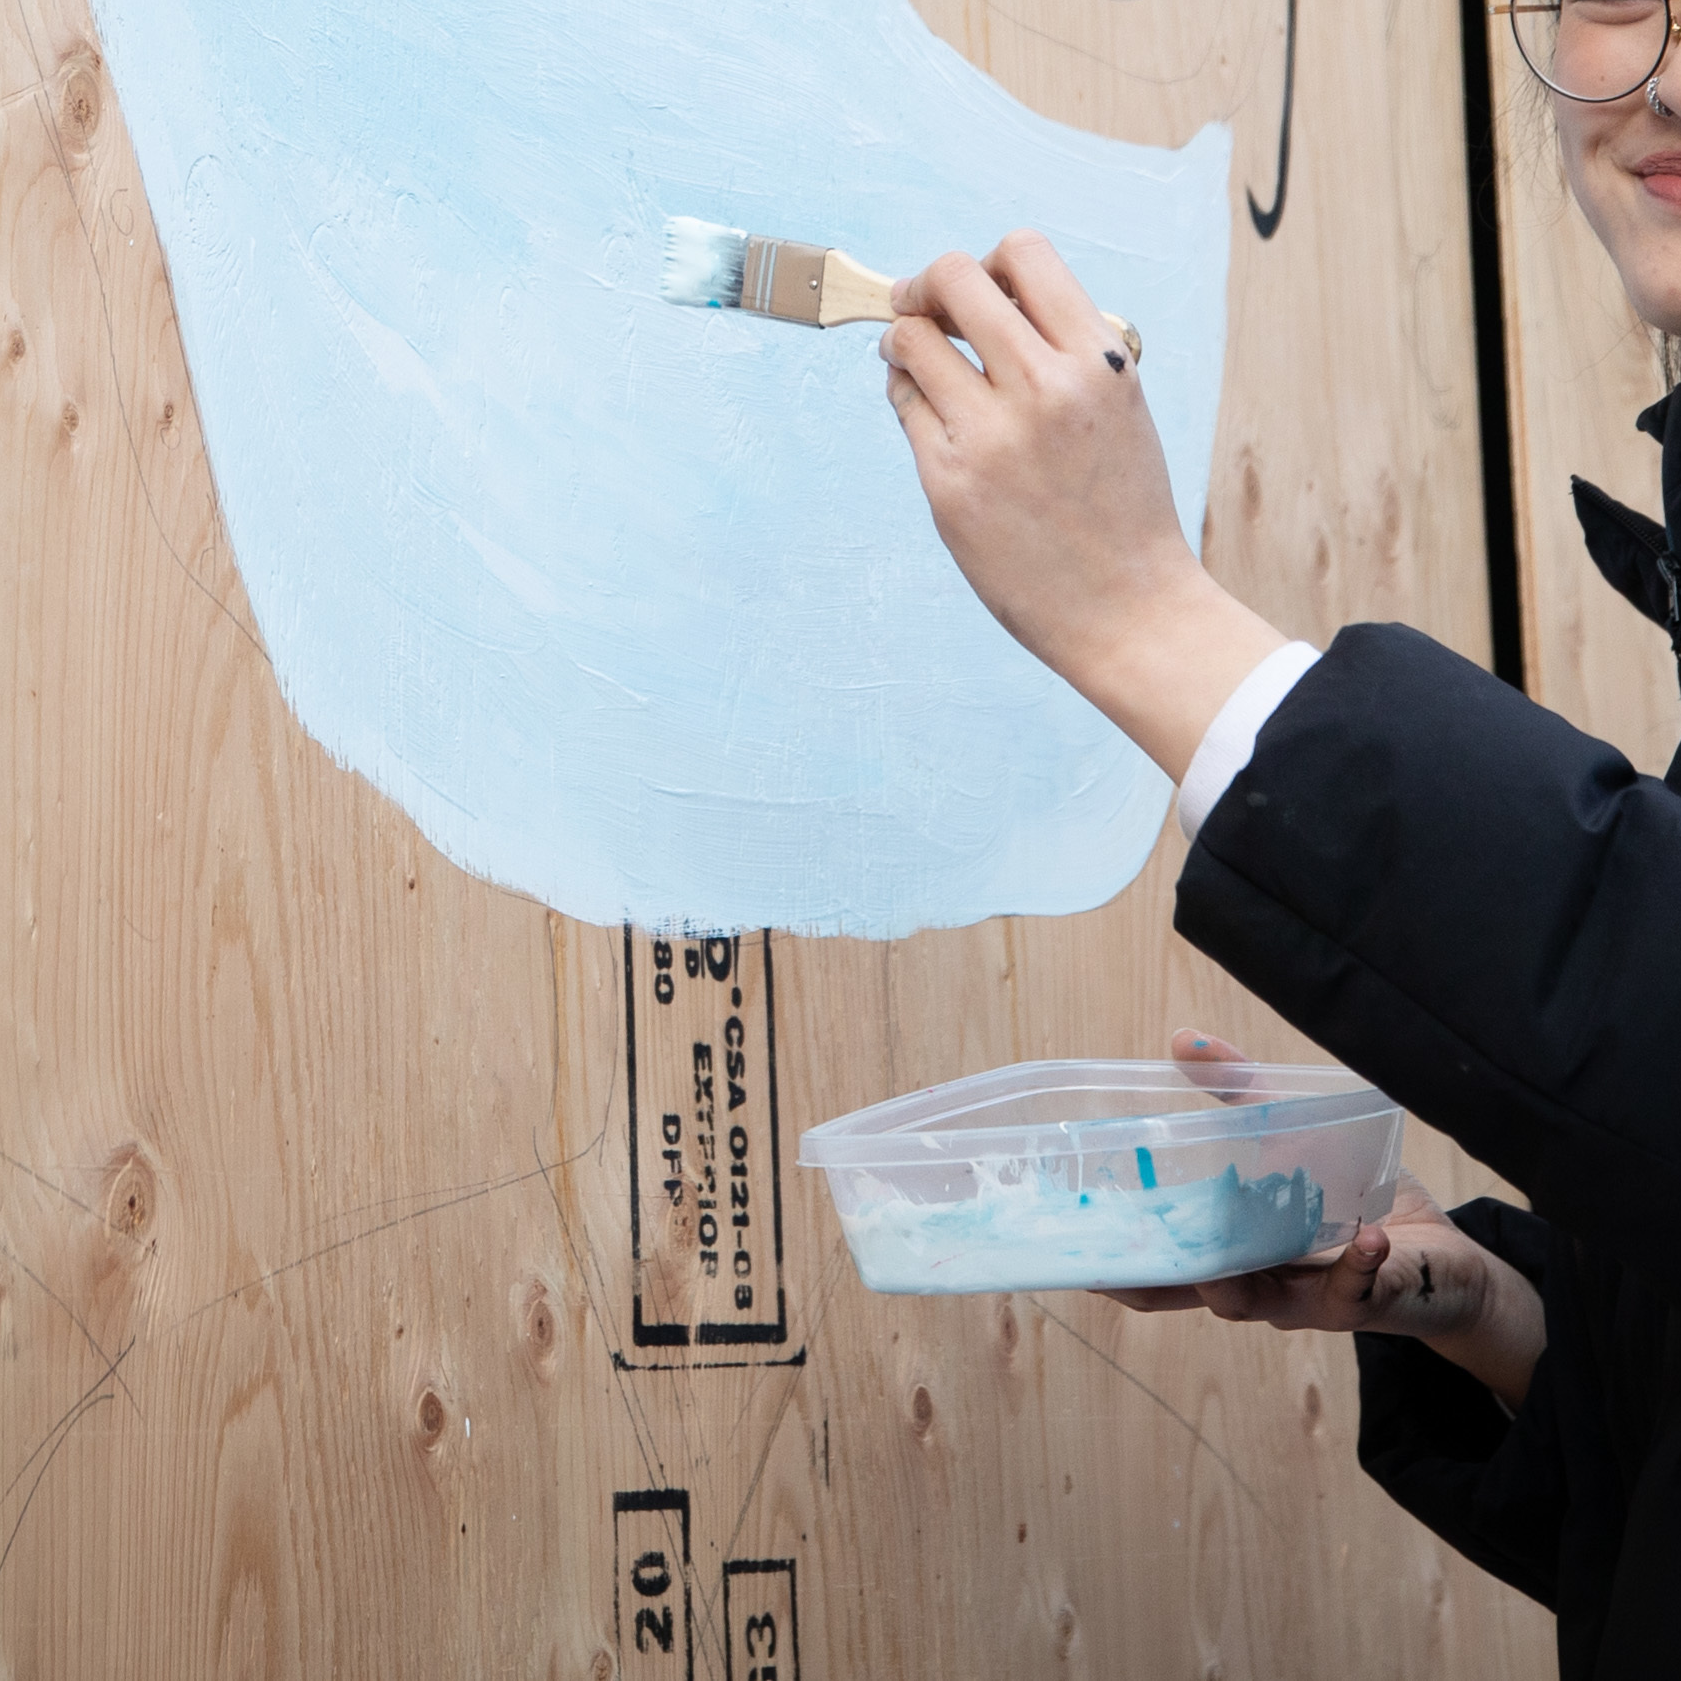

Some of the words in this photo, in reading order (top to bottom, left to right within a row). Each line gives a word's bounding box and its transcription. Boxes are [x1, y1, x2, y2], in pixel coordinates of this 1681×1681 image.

[724, 1016, 747, 1112] CSA
[661, 1113, 683, 1207] DFP
[631, 1550, 674, 1654] 20
[746, 1612, 779, 1681] 3
